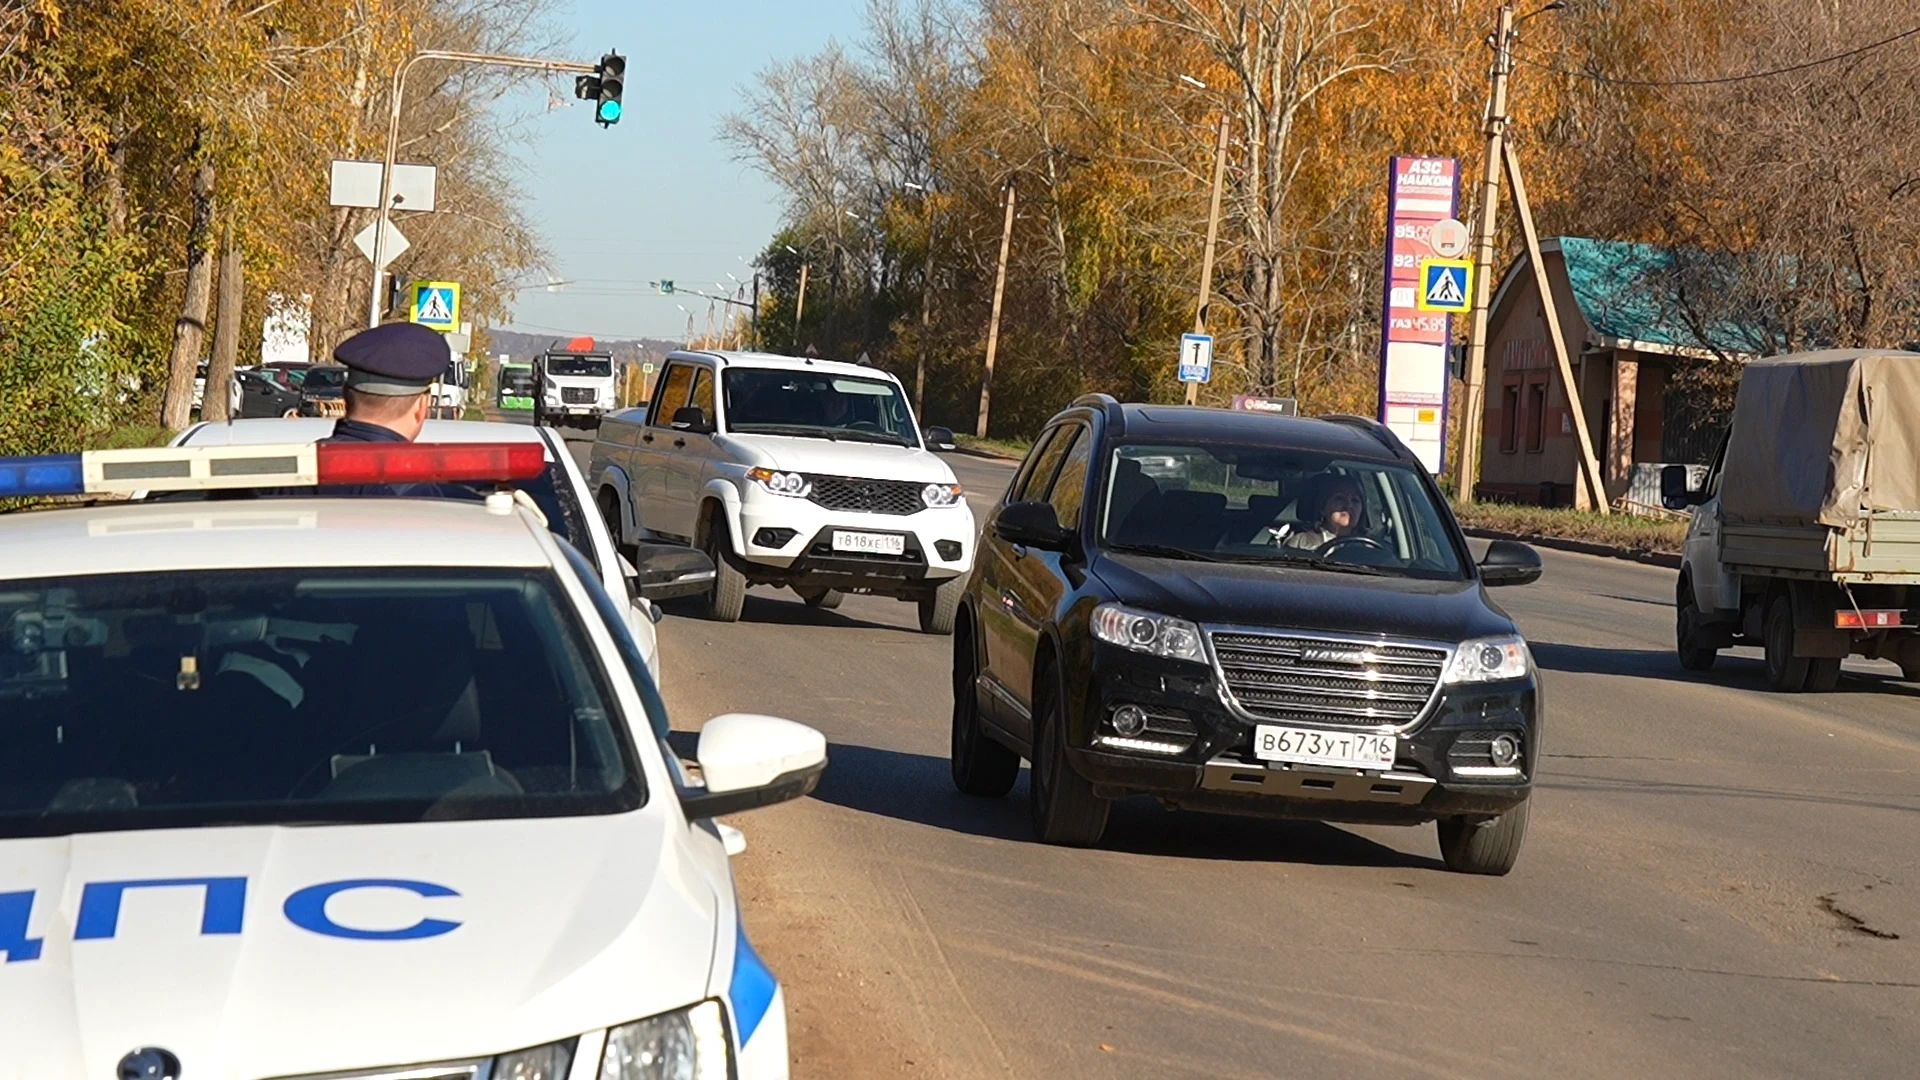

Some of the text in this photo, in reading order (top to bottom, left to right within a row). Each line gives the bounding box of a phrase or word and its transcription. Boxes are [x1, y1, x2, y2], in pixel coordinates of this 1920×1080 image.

[1408, 160, 1443, 174] АЗС
[1394, 225, 1415, 239] 95
[1393, 254, 1414, 268] 92
[1390, 318, 1412, 329] ГАЗ
[0, 877, 464, 964] ПС
